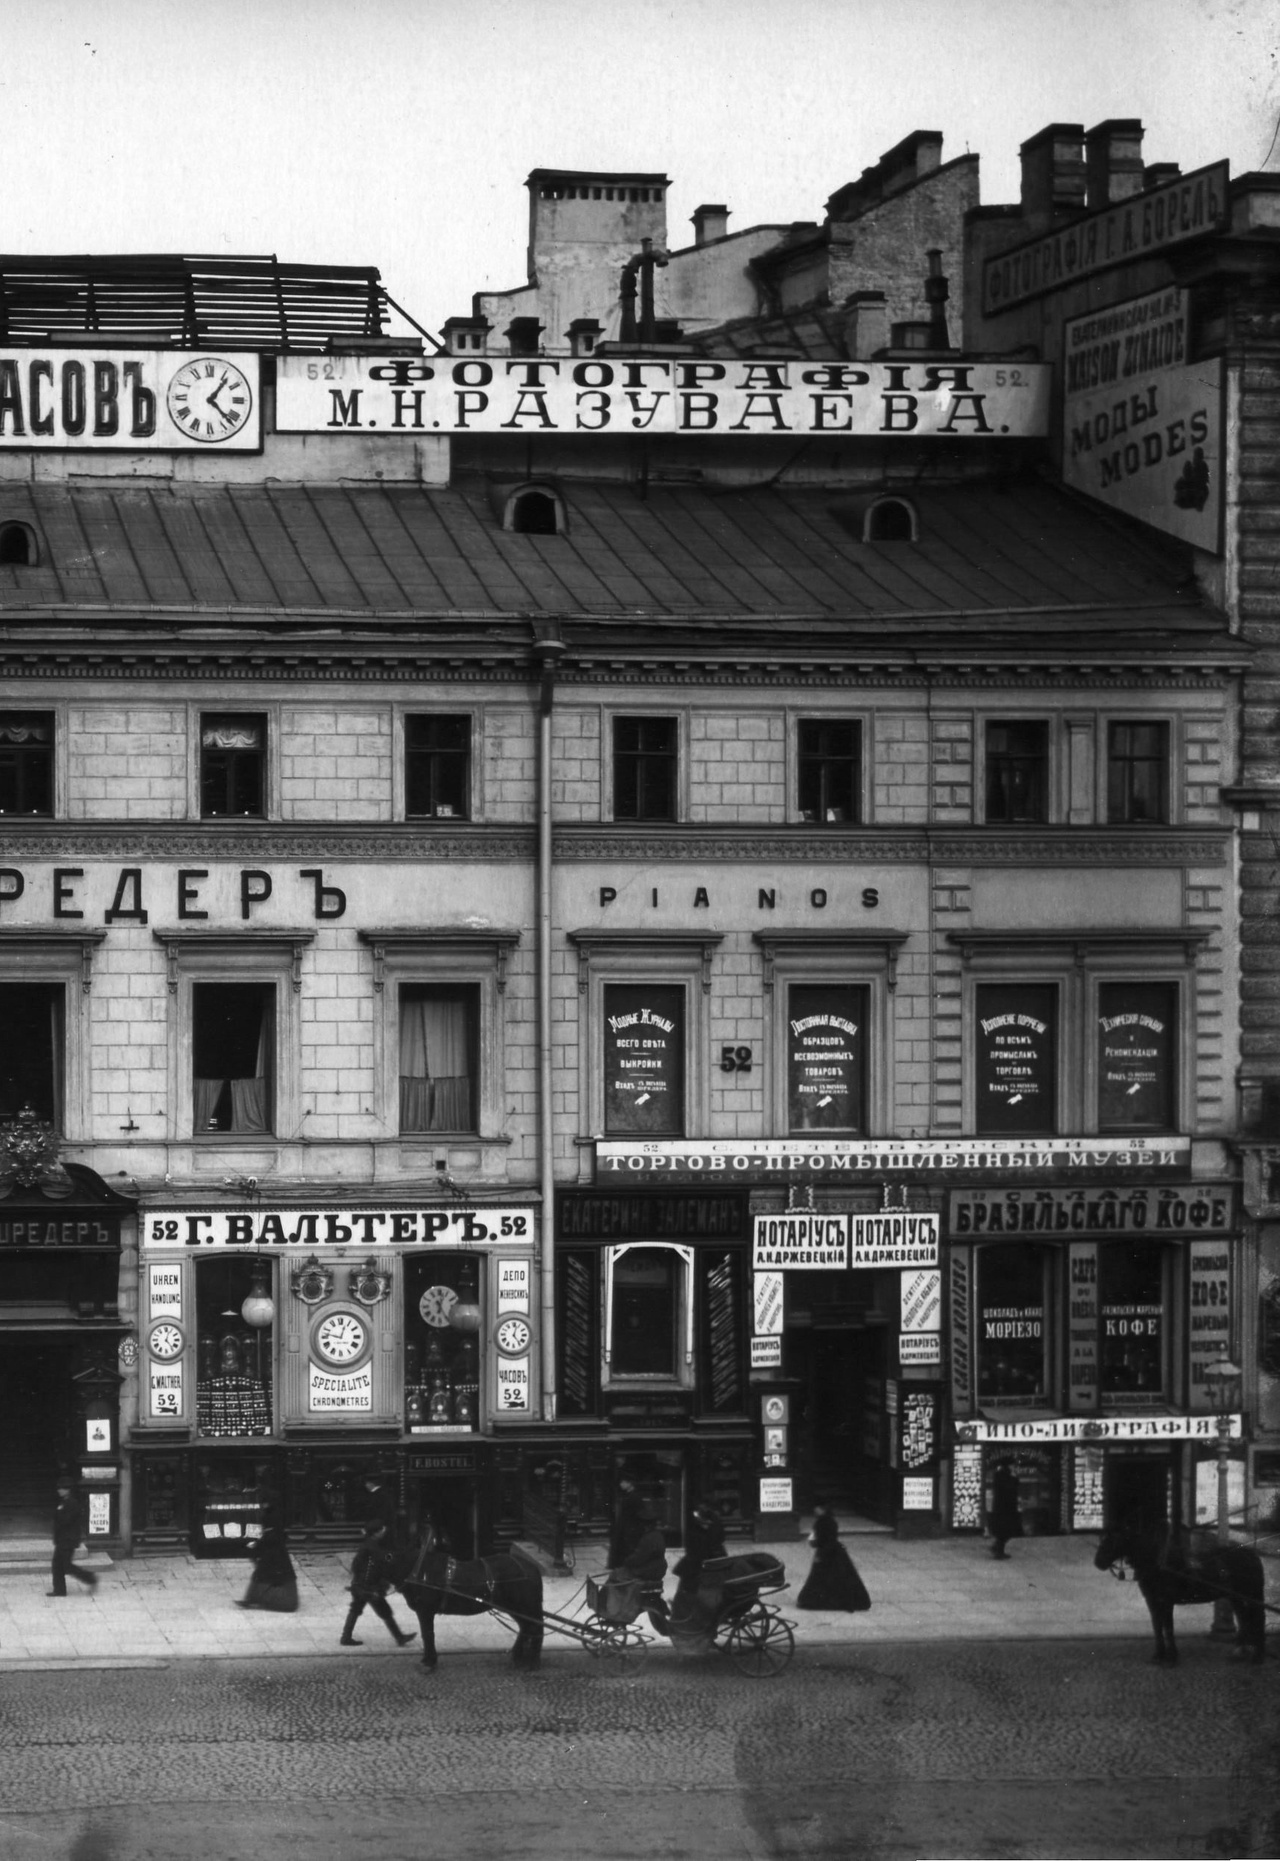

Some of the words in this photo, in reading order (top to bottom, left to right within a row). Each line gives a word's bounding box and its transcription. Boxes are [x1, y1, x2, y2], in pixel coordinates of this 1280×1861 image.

[368, 360, 974, 392] ФОТОГРАФІЯ
[1070, 385, 1159, 458] МОДЫ
[1098, 408, 1208, 489] MODES
[599, 886, 880, 910] PIANOS
[616, 1039, 639, 1048] ВСЕГО
[620, 1058, 662, 1068] ВЫКРОЙКИ
[721, 1046, 752, 1073] 52
[805, 1067, 843, 1077] ТОВАРОВЪ
[606, 1151, 1054, 1171] ТОРГОВО-ПРОМЫШЛЕННЫЙ
[1068, 1149, 1178, 1166] МУЗЕЙ
[500, 1216, 527, 1236] 52
[956, 1201, 1147, 1233] БРАЗИЛЬСКАГО
[1156, 1199, 1227, 1229] КОФЕ
[152, 1220, 179, 1241] 52
[185, 1215, 214, 1244] Г.
[757, 1217, 845, 1247] НОТАРІУСЪ
[855, 1216, 937, 1247] НОТАРІУСЪ
[153, 1275, 179, 1285] UHREN
[503, 1270, 525, 1281] ДЕПО
[1192, 1281, 1227, 1306] КОФЕ
[983, 1307, 1018, 1318] ШОКОЛАДЪ
[985, 1320, 1041, 1338] МОРІЕЗО
[1106, 1319, 1157, 1336] КОФЕ
[901, 1337, 939, 1349] НОТАРІУСЪ
[500, 1370, 527, 1383] ЧАСОВЪ
